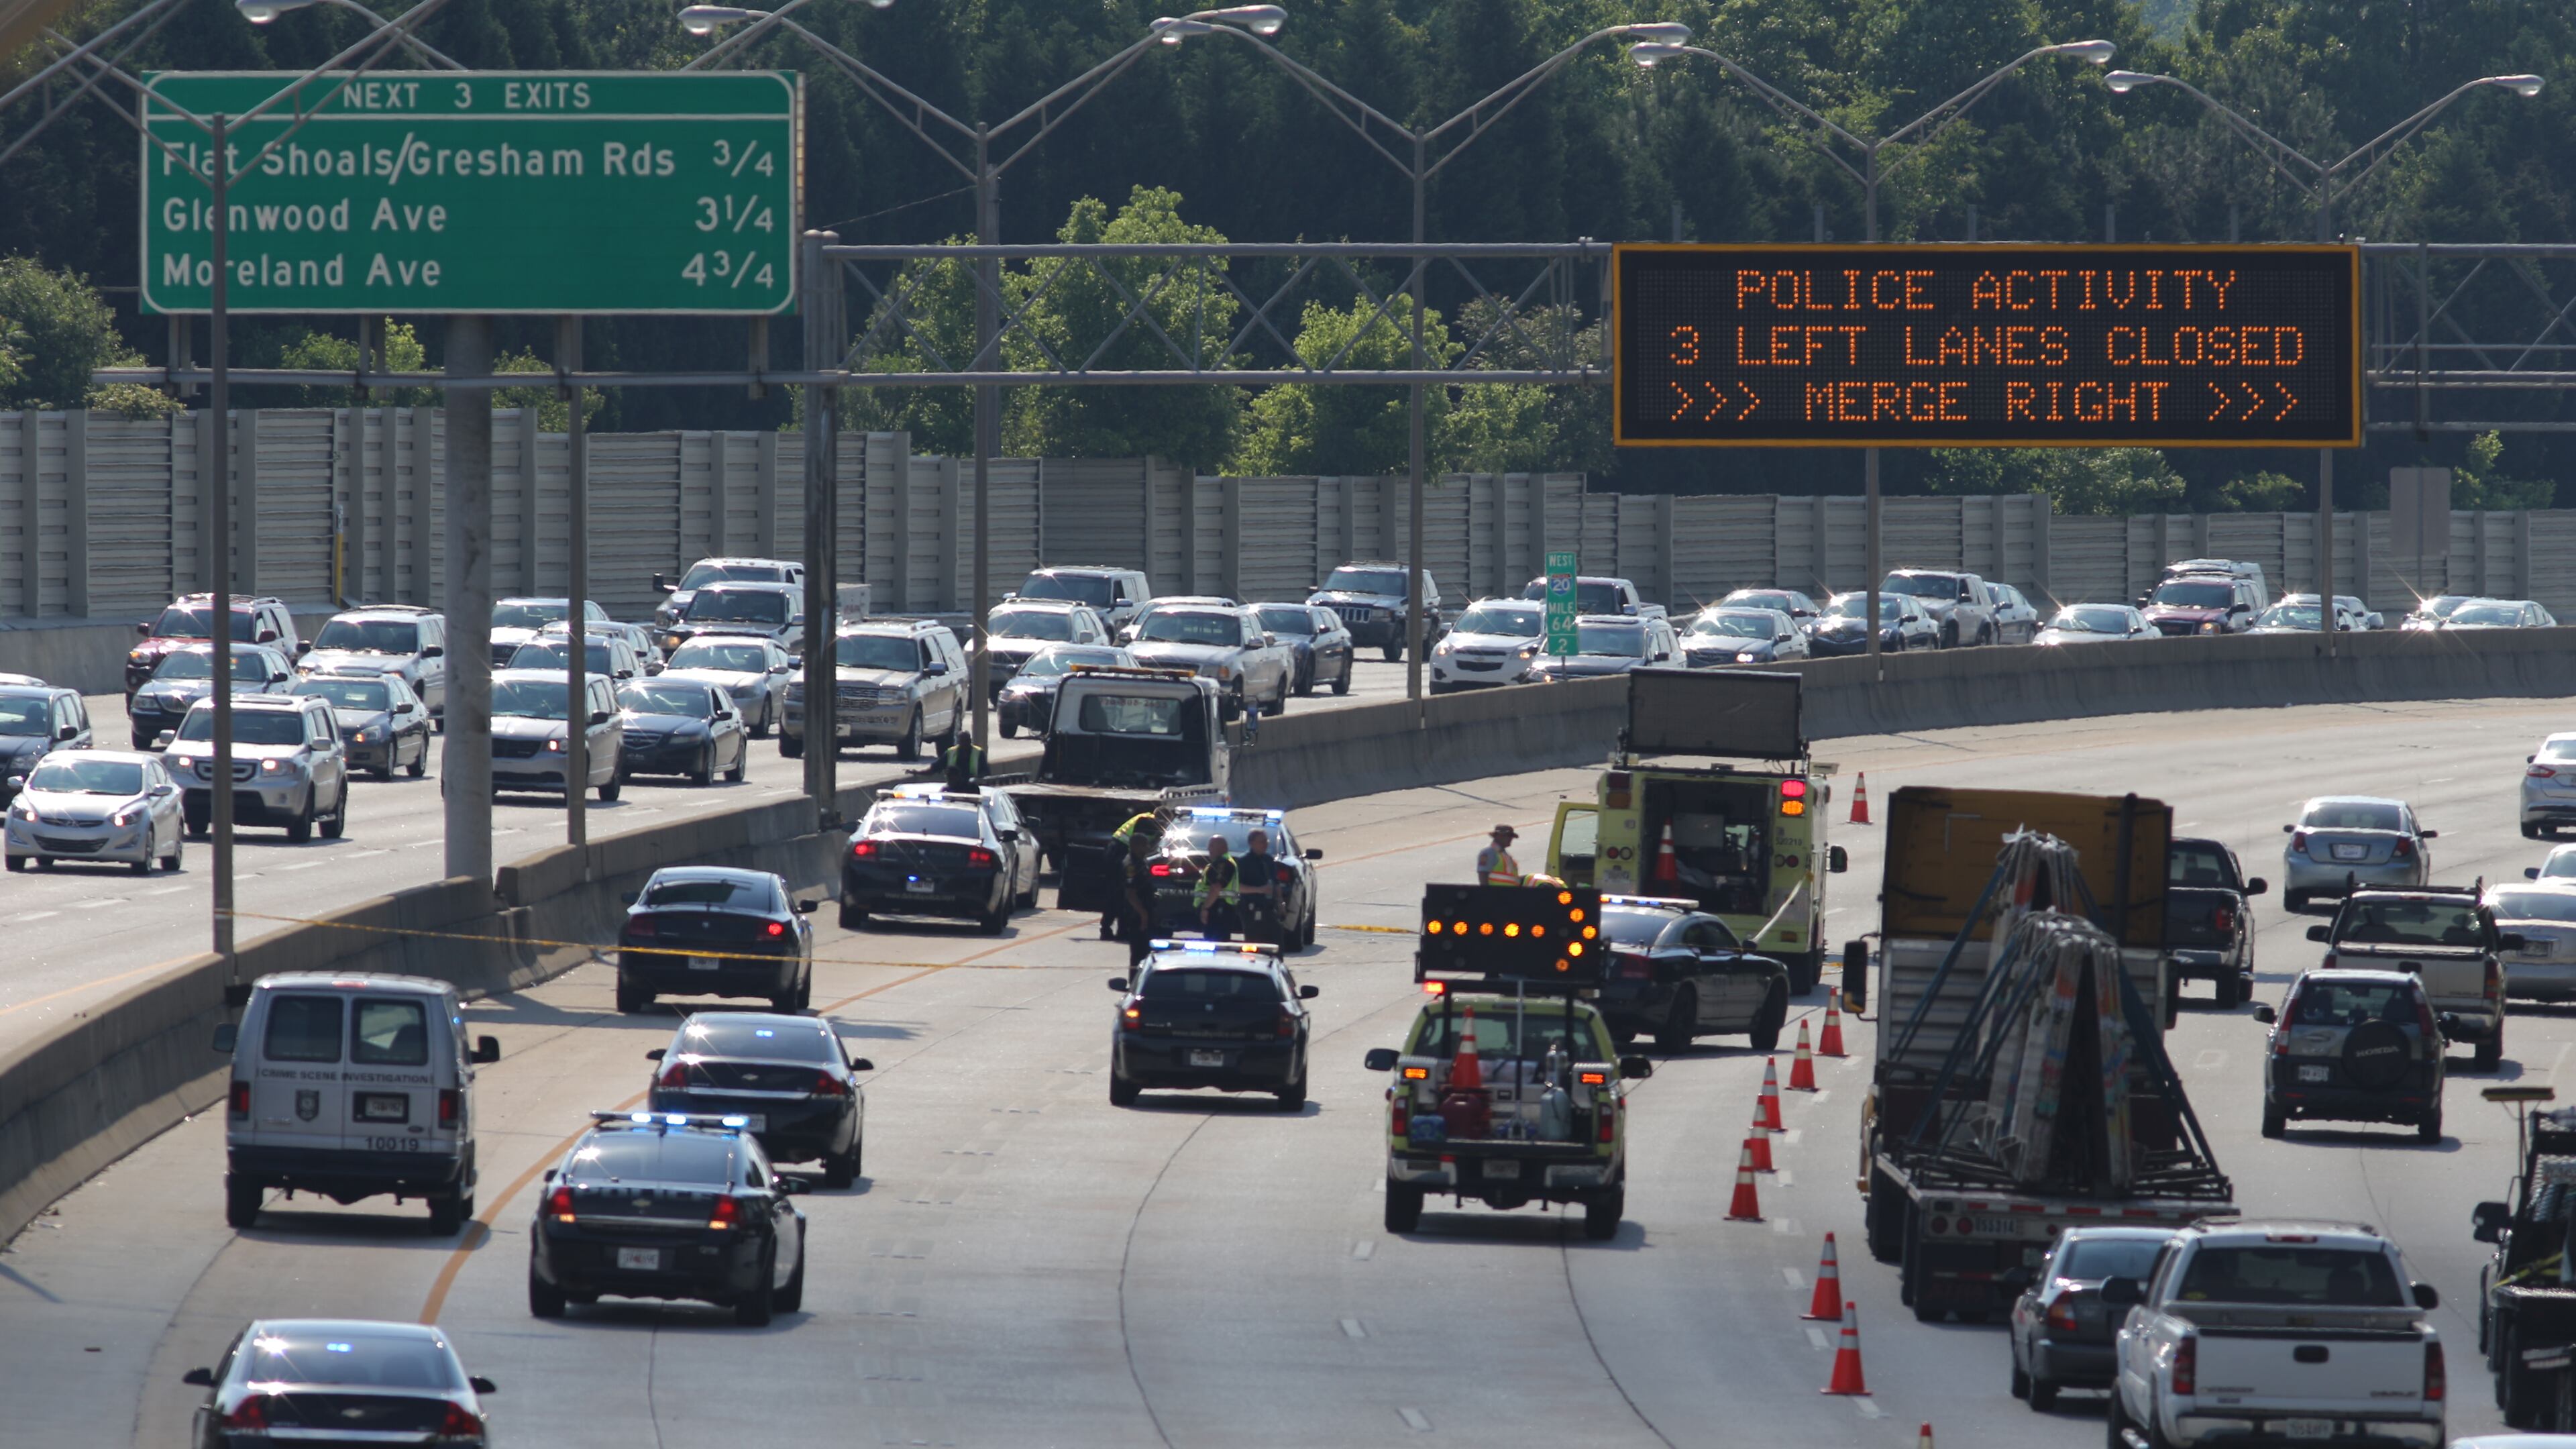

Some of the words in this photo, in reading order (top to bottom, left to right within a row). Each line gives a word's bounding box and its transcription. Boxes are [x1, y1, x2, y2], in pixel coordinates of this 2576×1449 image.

[343, 83, 420, 108] NEXT
[454, 83, 472, 109] 3
[504, 83, 591, 109] EXITS
[163, 142, 239, 176] Flat
[262, 132, 584, 185] Shoals/Gresham
[603, 142, 676, 176] Rds
[163, 197, 349, 232] Glenwood
[371, 197, 447, 232] Ave
[366, 253, 441, 286] Ave
[1737, 270, 1935, 310] POLICE
[1972, 270, 2237, 310] ACTIVITY
[1670, 326, 1699, 366] 3
[1737, 326, 1867, 366] LEFT
[1905, 326, 2069, 366] LANES
[2107, 326, 2303, 366] CLOSED
[1806, 381, 1968, 421] MERGE
[2006, 381, 2169, 421] RIGHT
[1548, 554, 1572, 567] WEST
[1552, 579, 1570, 592] 20
[1548, 601, 1574, 614] MILE
[1552, 616, 1572, 631] 64
[1556, 638, 1568, 653] 2
[1156, 888, 1195, 896] DEKAL
[261, 1068, 297, 1079] CRIME
[300, 1071, 337, 1081] SCENE
[341, 1072, 428, 1084] INVESTIGATION
[366, 1136, 420, 1152] 10019
